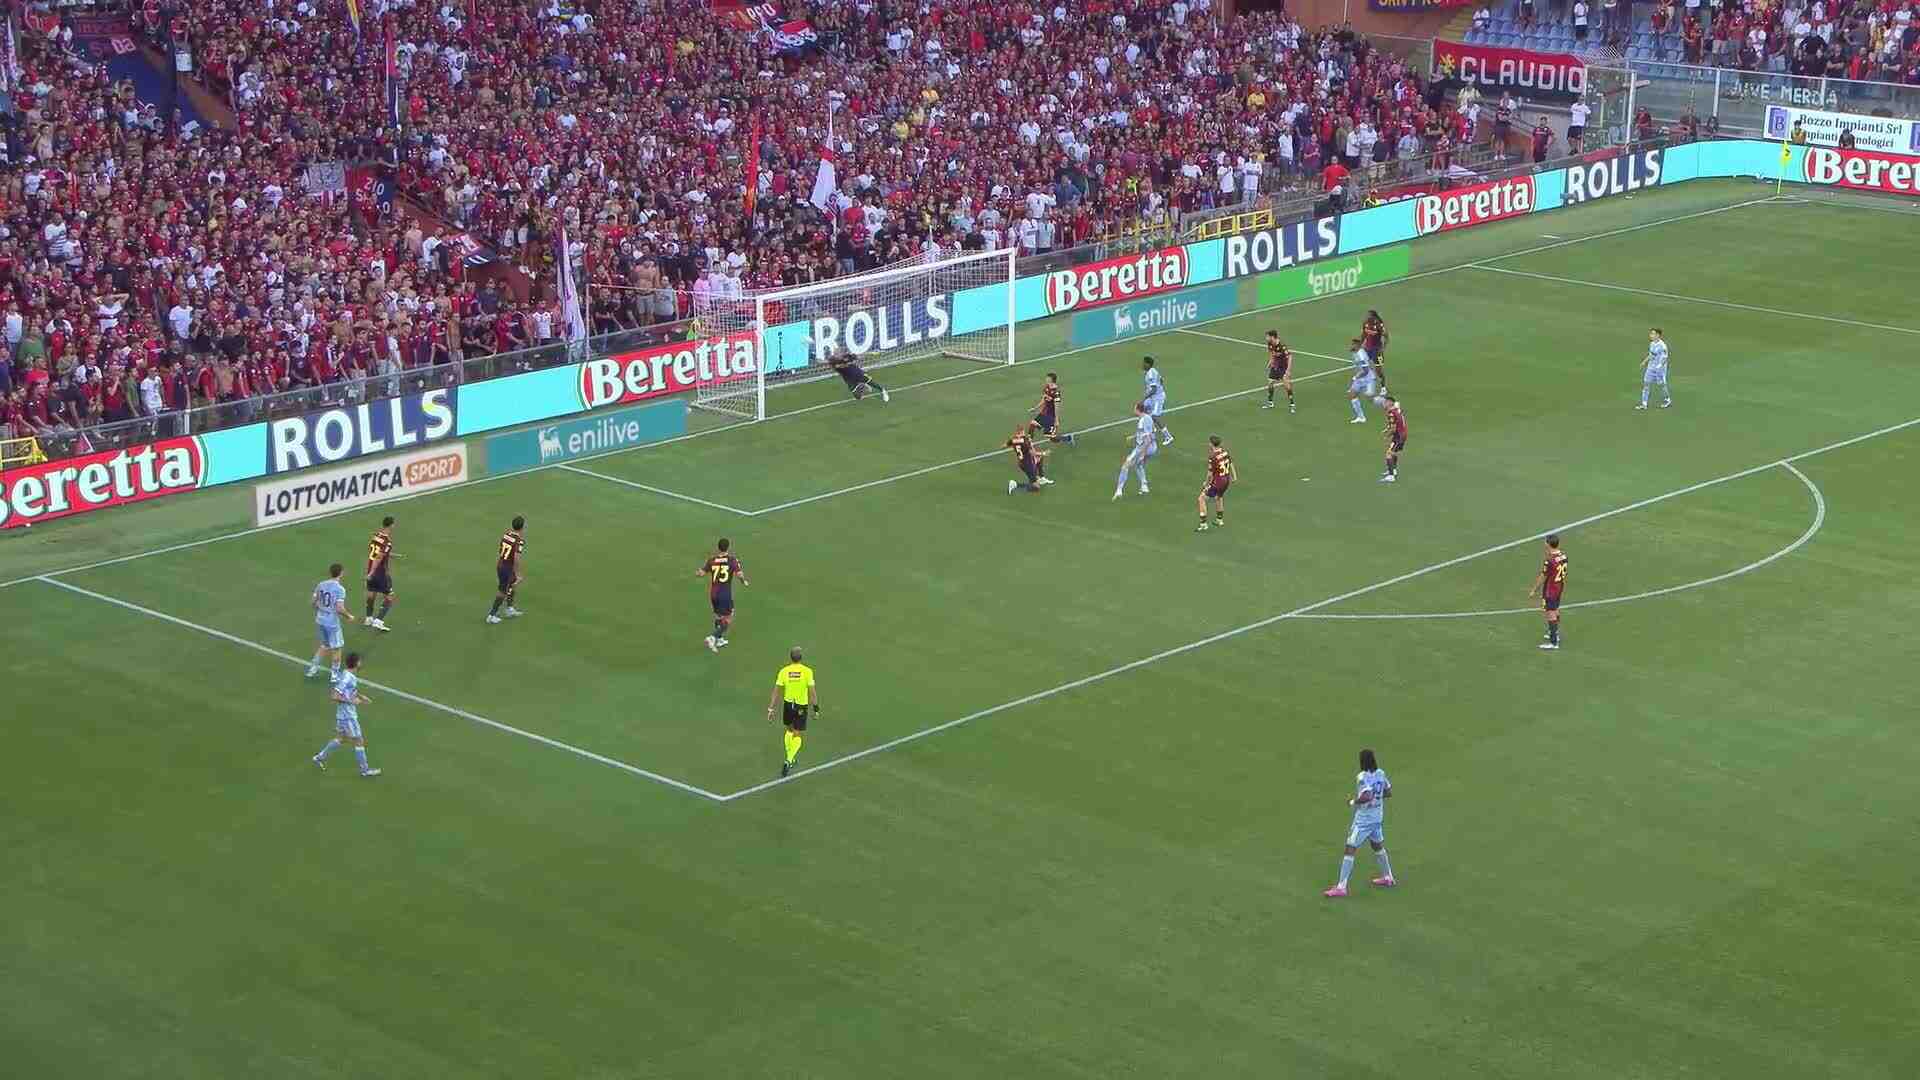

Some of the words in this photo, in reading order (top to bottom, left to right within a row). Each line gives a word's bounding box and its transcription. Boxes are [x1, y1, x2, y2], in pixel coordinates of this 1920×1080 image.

[1460, 56, 1584, 93] CLAUDIO
[1835, 117, 1884, 132] Impianti
[1567, 150, 1660, 204] ROLLS
[1421, 180, 1530, 234] Beretta
[1227, 217, 1337, 277] ROLLS
[1053, 250, 1183, 313] Beretta
[814, 295, 949, 361] ROLLS
[1139, 298, 1198, 330] enilive
[588, 335, 757, 403] Beretta
[273, 389, 453, 472] ROLLS
[569, 417, 640, 454] enilive
[264, 467, 403, 517] LOTTOMATICA
[409, 456, 457, 482] SPORT
[320, 590, 331, 608] 10
[711, 565, 729, 583] 73
